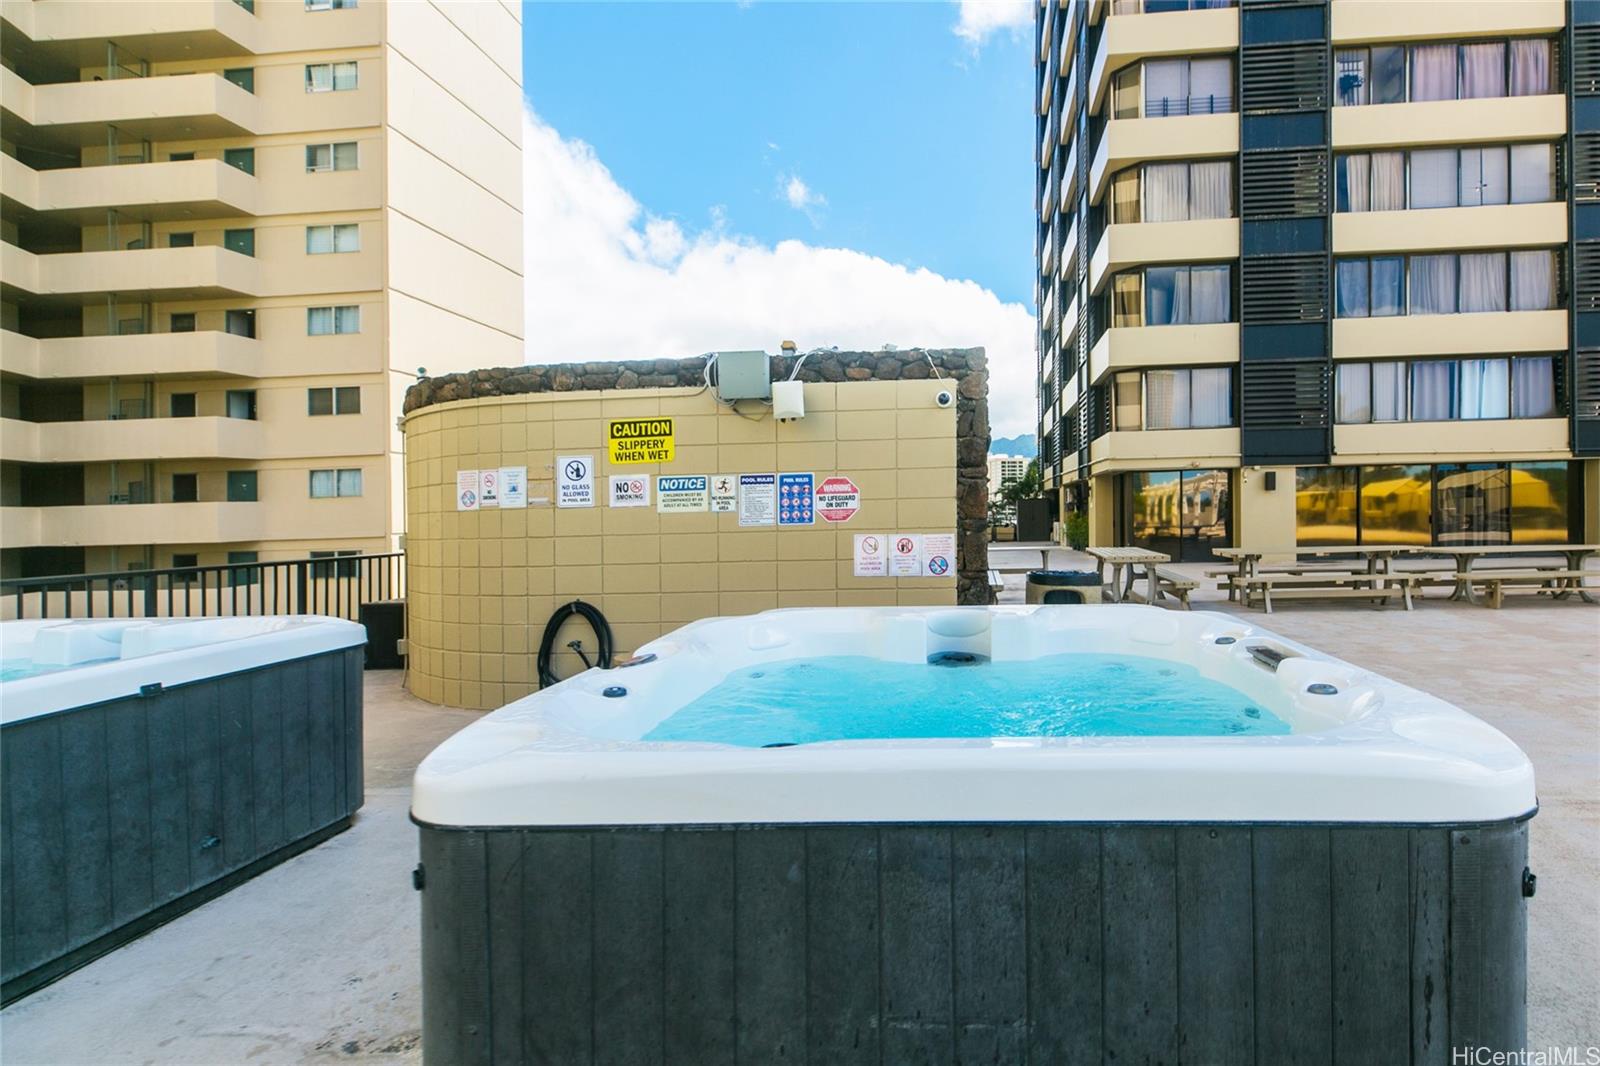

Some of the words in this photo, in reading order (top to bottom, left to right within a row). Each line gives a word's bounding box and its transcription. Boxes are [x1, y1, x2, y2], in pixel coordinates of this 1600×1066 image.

[613, 421, 670, 437] CAUTION
[618, 439, 665, 451] SLIPPERY
[615, 451, 645, 462] WHEN
[648, 450, 669, 460] WET
[616, 482, 629, 493] NO
[660, 478, 705, 490] NOTICE
